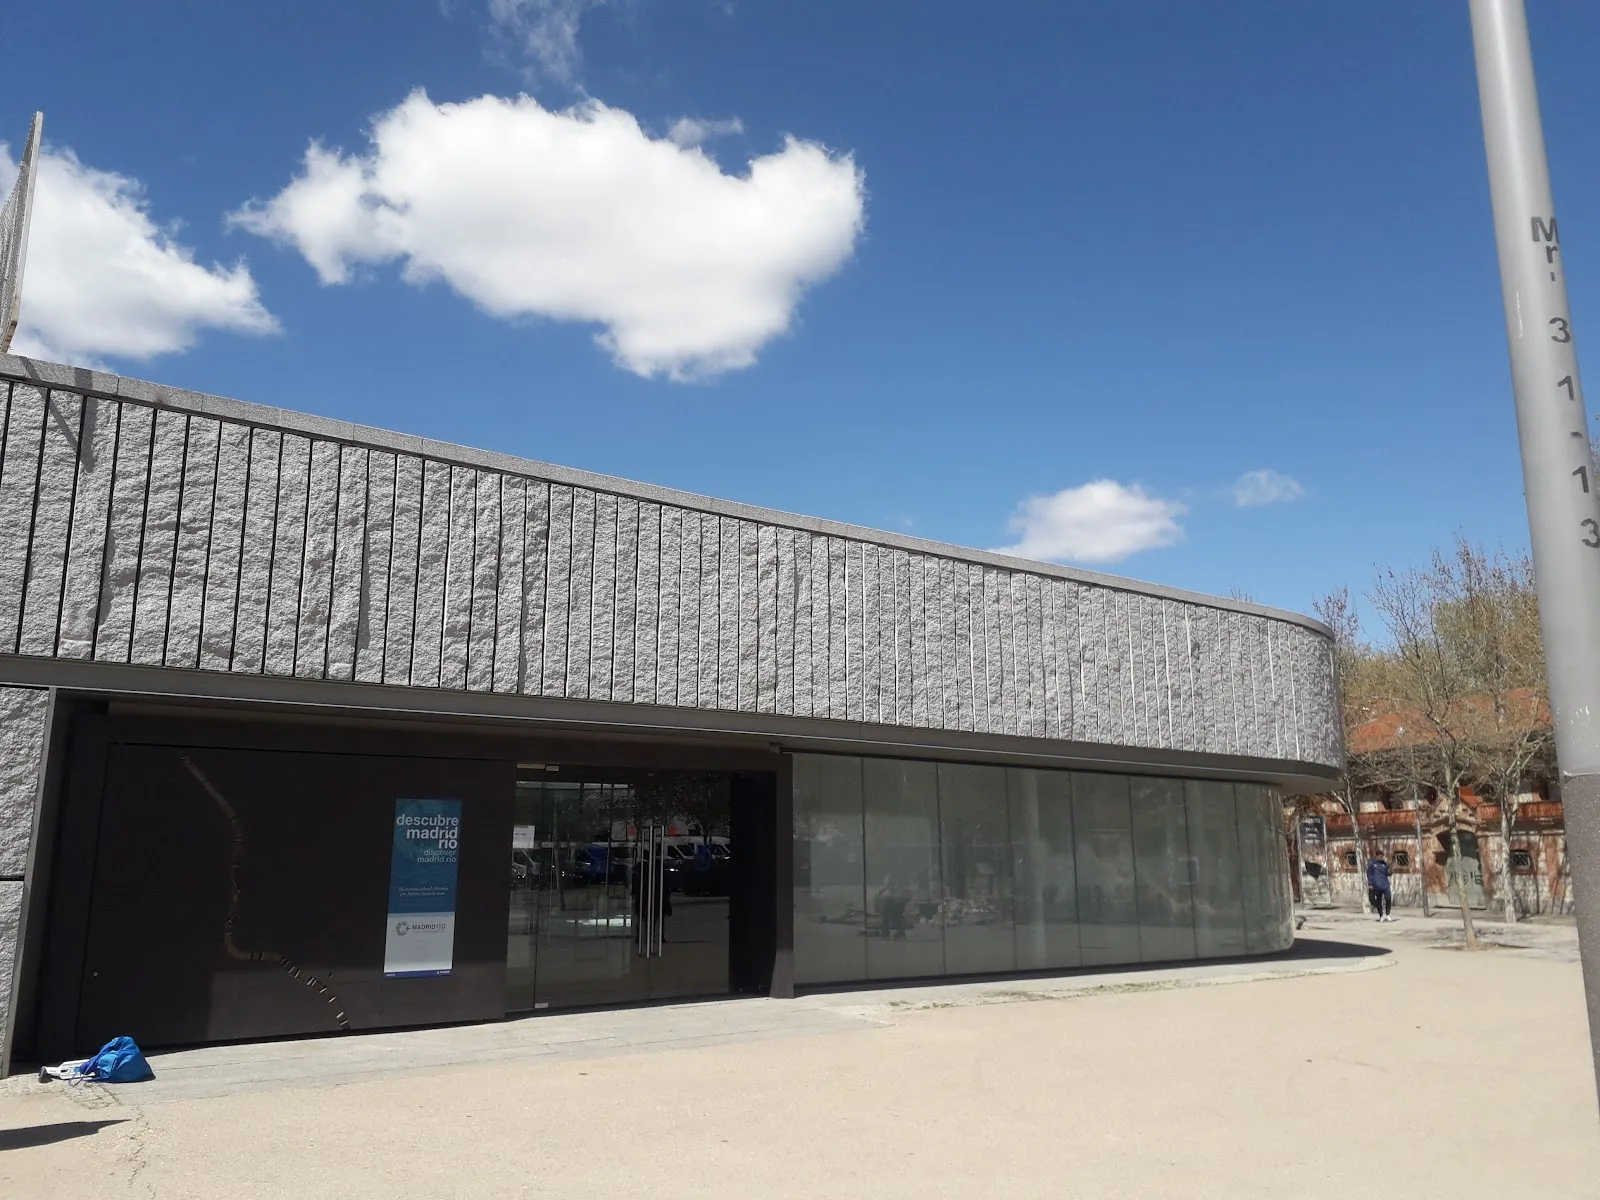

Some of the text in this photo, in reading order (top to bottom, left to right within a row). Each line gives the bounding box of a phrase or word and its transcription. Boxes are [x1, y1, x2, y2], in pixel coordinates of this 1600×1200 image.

[396, 813, 459, 826] descubre
[406, 826, 459, 839] madrid
[417, 855, 445, 863] madrid
